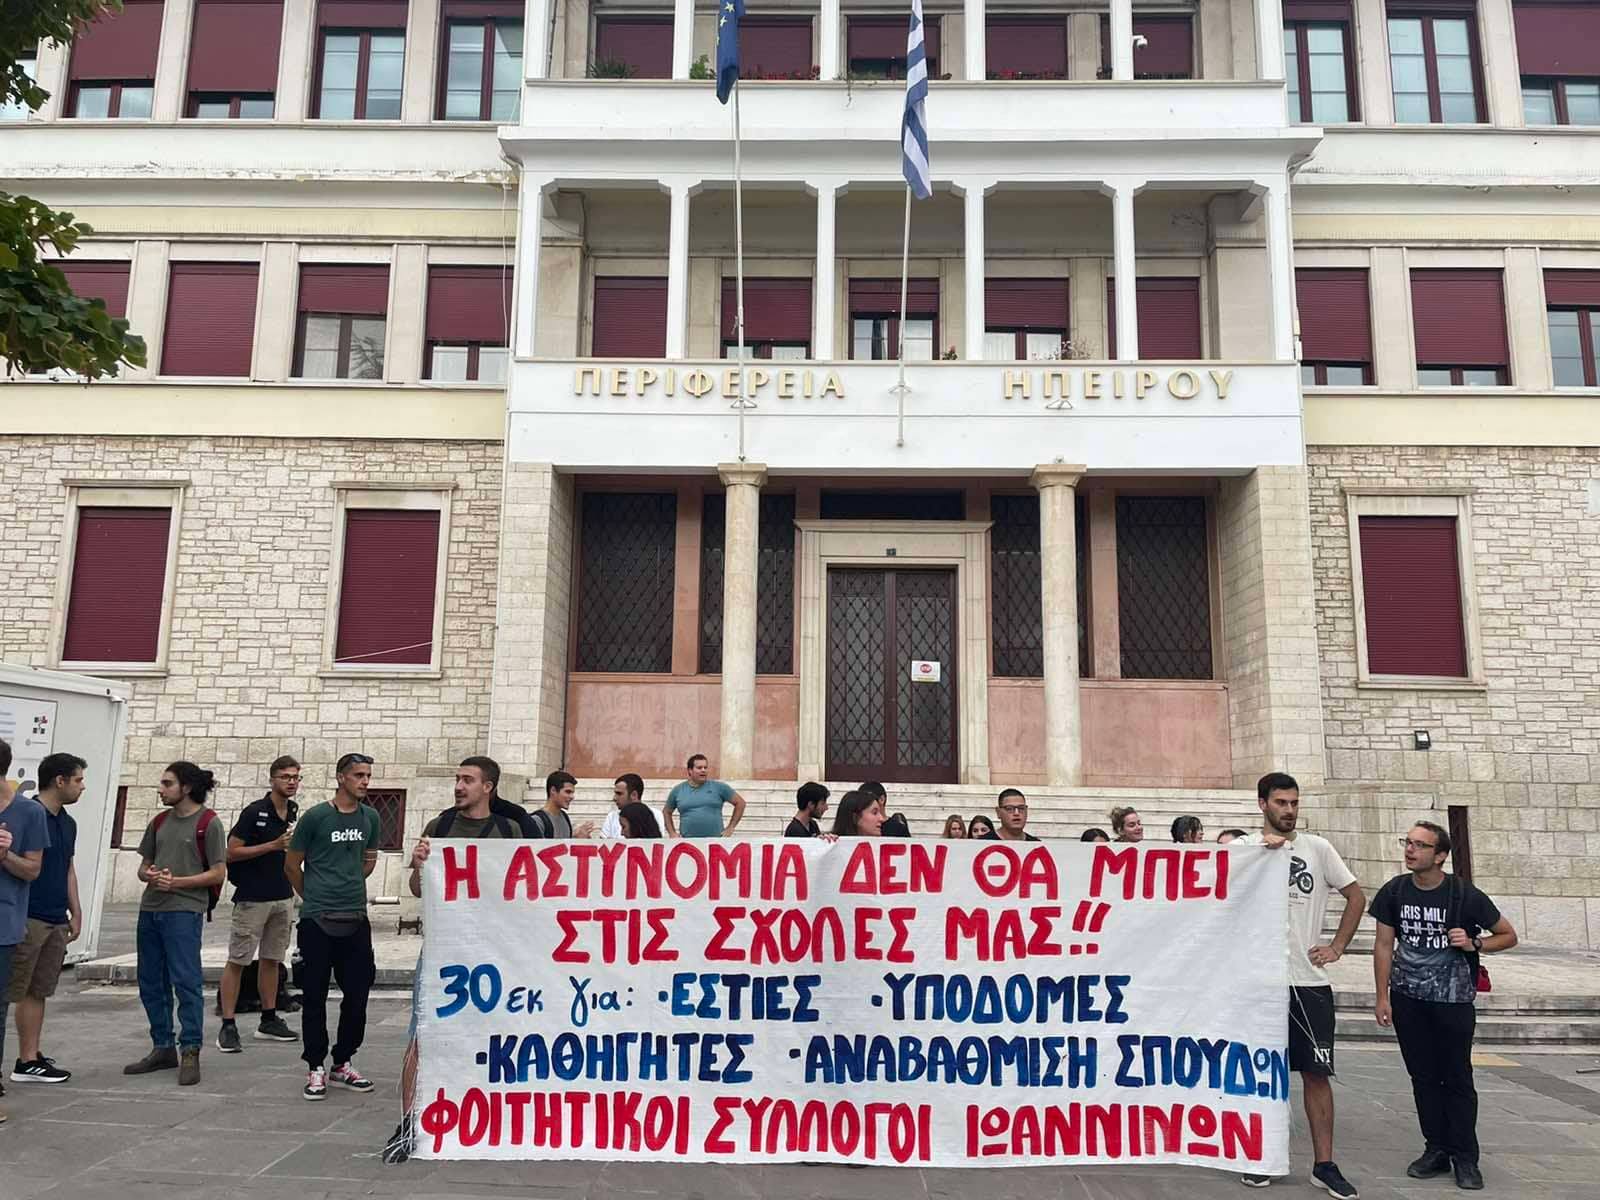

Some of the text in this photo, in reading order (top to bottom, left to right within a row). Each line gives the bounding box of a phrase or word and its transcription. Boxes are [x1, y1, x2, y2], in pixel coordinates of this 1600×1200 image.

[574, 366, 1234, 400] ΠΕΡΙΦΕΡΕΙΑ ΗΠΕΙΡΟΥ
[443, 841, 1230, 901] Η ΑΣΤΥΝΟΜΙΑ ΔΕΝ ΘΑ ΜΠΕΙ
[552, 900, 1112, 965] ΣΤΙΣ ΣΧΟΛΕΣ ΜΑΣ!!
[1114, 1034, 1290, 1102] ΣΠΟΥΔΩΝ
[421, 1087, 1263, 1163] ΦΟΙΤΗΤΙΚΟΙ ΣΥΛΛΟΓΟΙ ΙΩΑΝΝΙΝΩΝ
